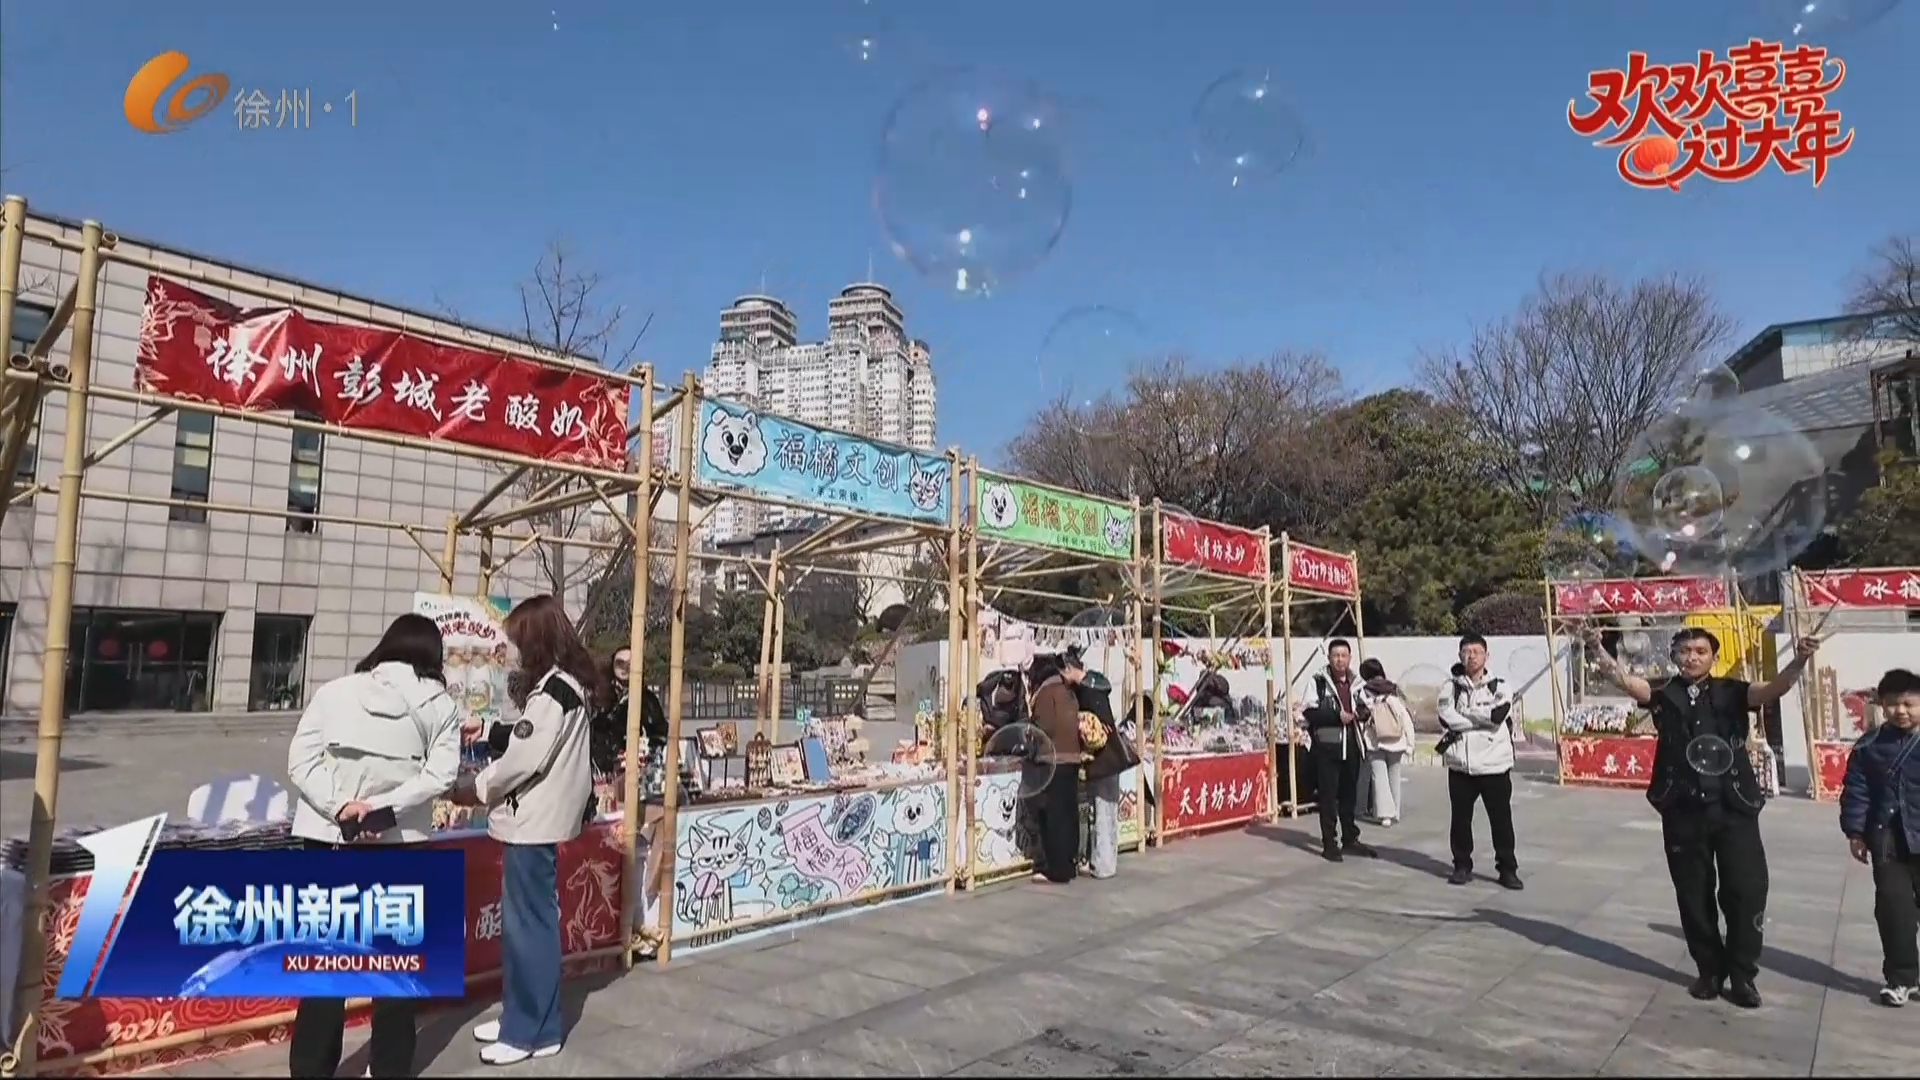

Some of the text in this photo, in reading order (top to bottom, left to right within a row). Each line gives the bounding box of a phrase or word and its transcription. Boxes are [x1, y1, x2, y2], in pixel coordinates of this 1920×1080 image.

[205, 330, 588, 444] 徐州彭城老酸奶
[773, 429, 899, 494] 福橘文创
[1178, 776, 1253, 816] 天青坊朱砂
[105, 1011, 175, 1047] 2026
